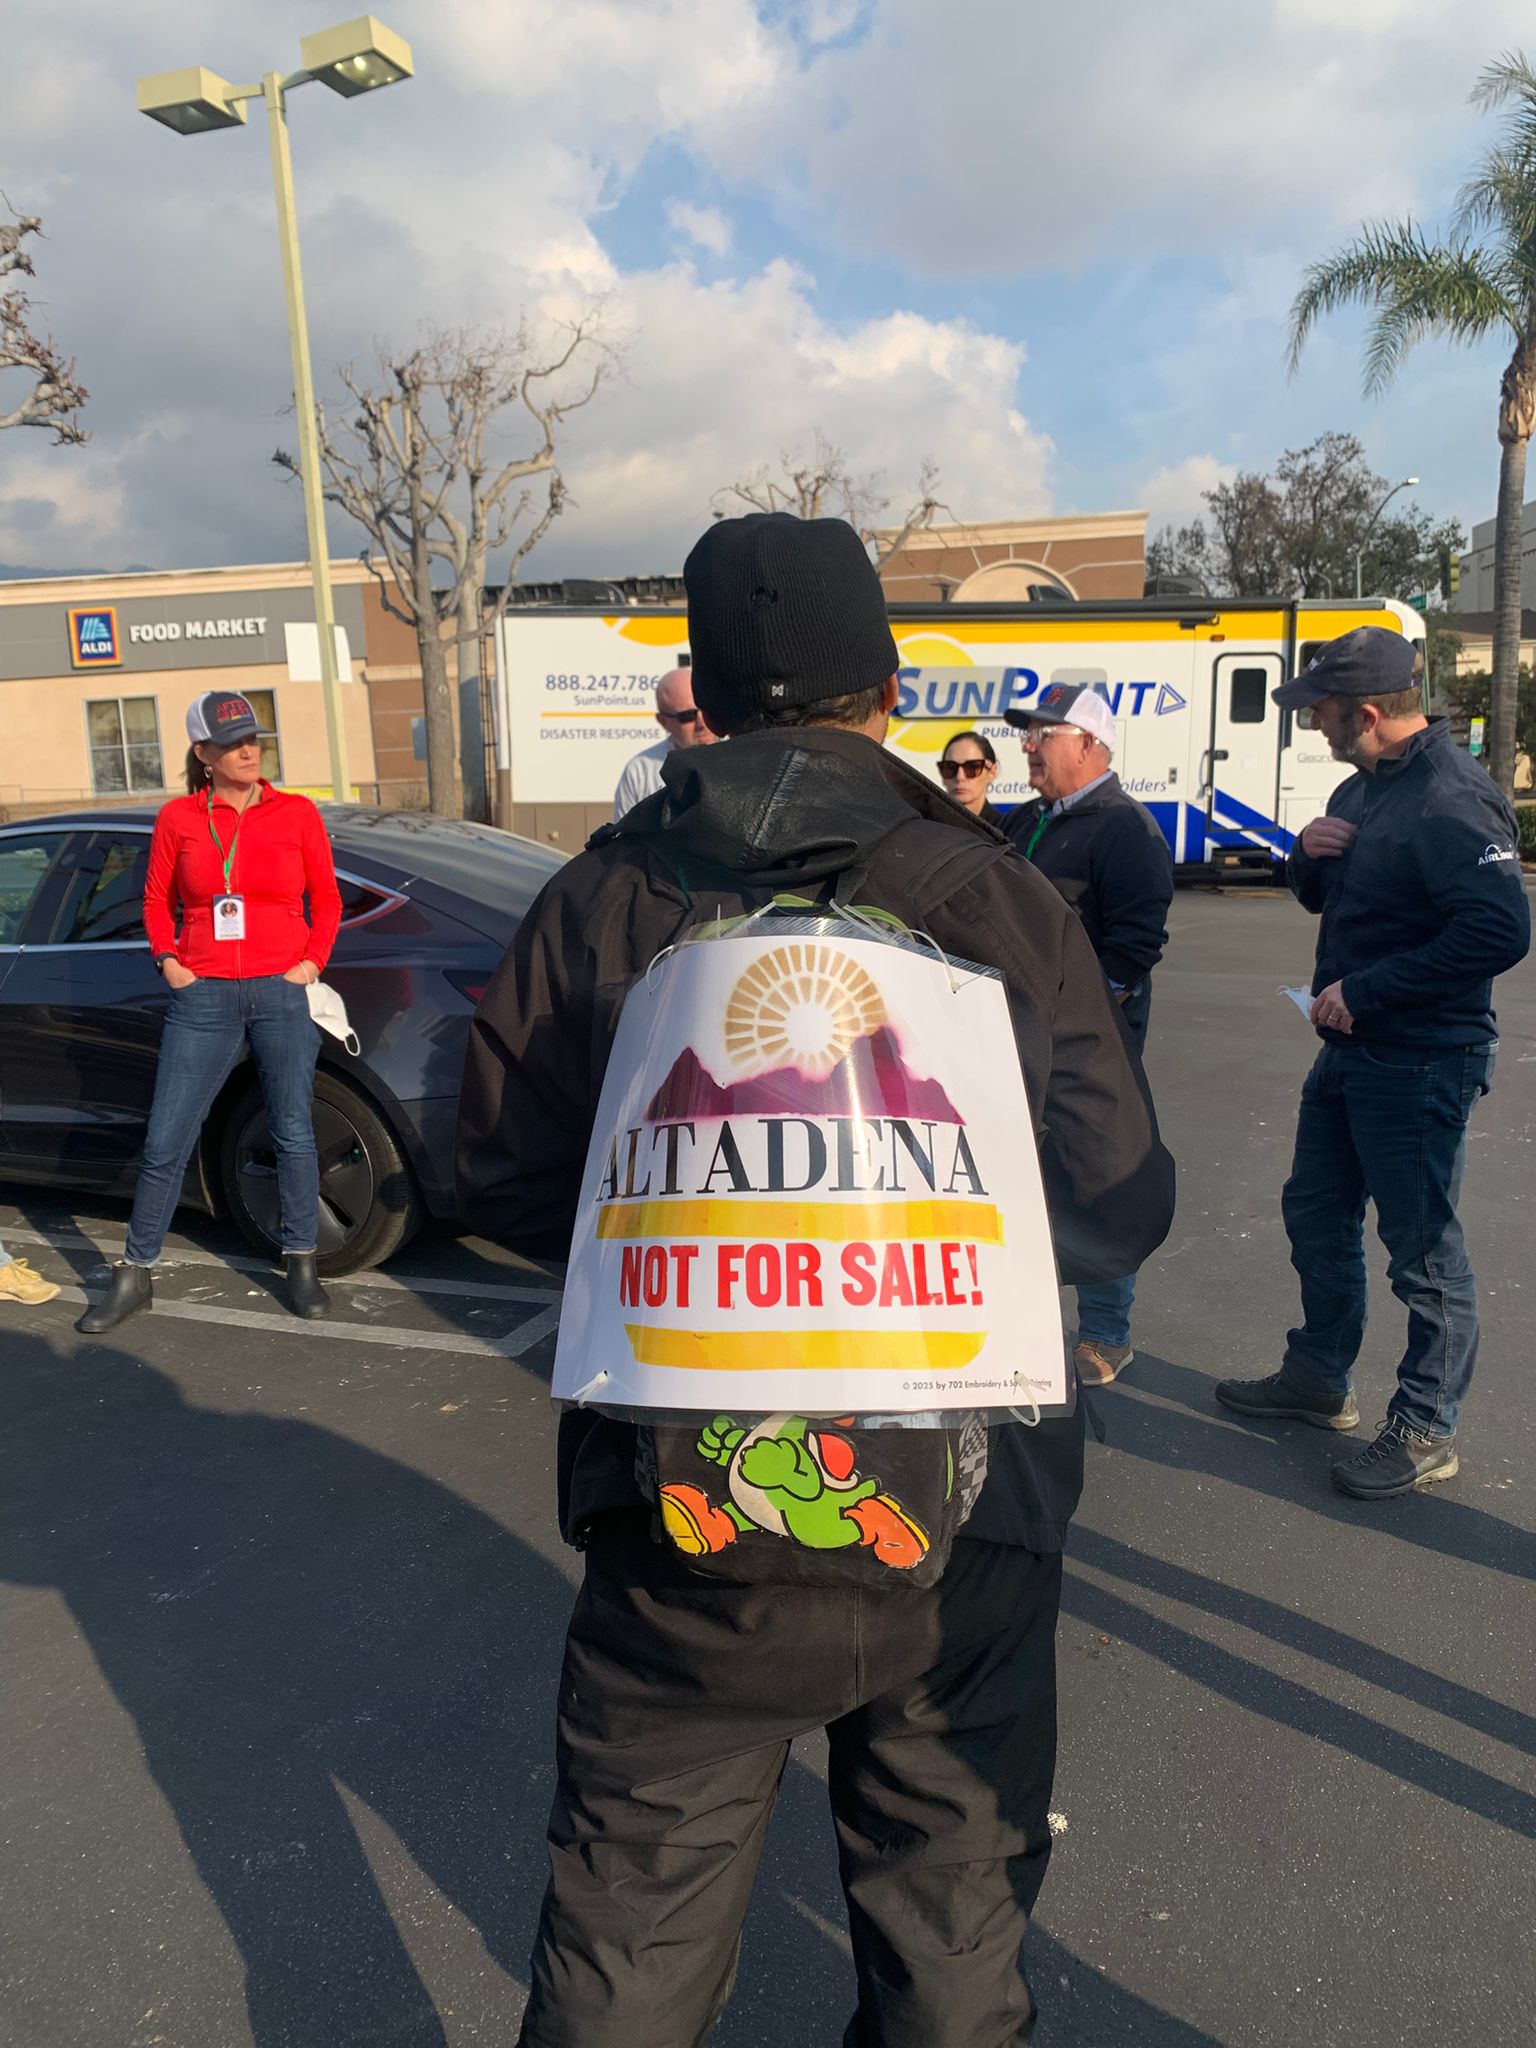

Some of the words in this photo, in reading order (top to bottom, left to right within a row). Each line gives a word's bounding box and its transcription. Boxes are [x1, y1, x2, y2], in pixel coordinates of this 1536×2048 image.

[129, 622, 180, 643] FOOD
[185, 617, 267, 639] MARKET
[81, 641, 113, 654] ALDI
[573, 695, 646, 706] SunPoint.us
[540, 728, 597, 740] DISASTER
[599, 728, 660, 740] RESPONSE
[595, 1118, 989, 1201] ALTADENA
[620, 1245, 699, 1307] NOT
[717, 1243, 823, 1309] FOR
[841, 1242, 983, 1308] SALE!
[912, 1381, 934, 1389] 2025
[936, 1380, 946, 1391] by
[948, 1380, 963, 1389] 702
[965, 1379, 1002, 1390] Embroidery
